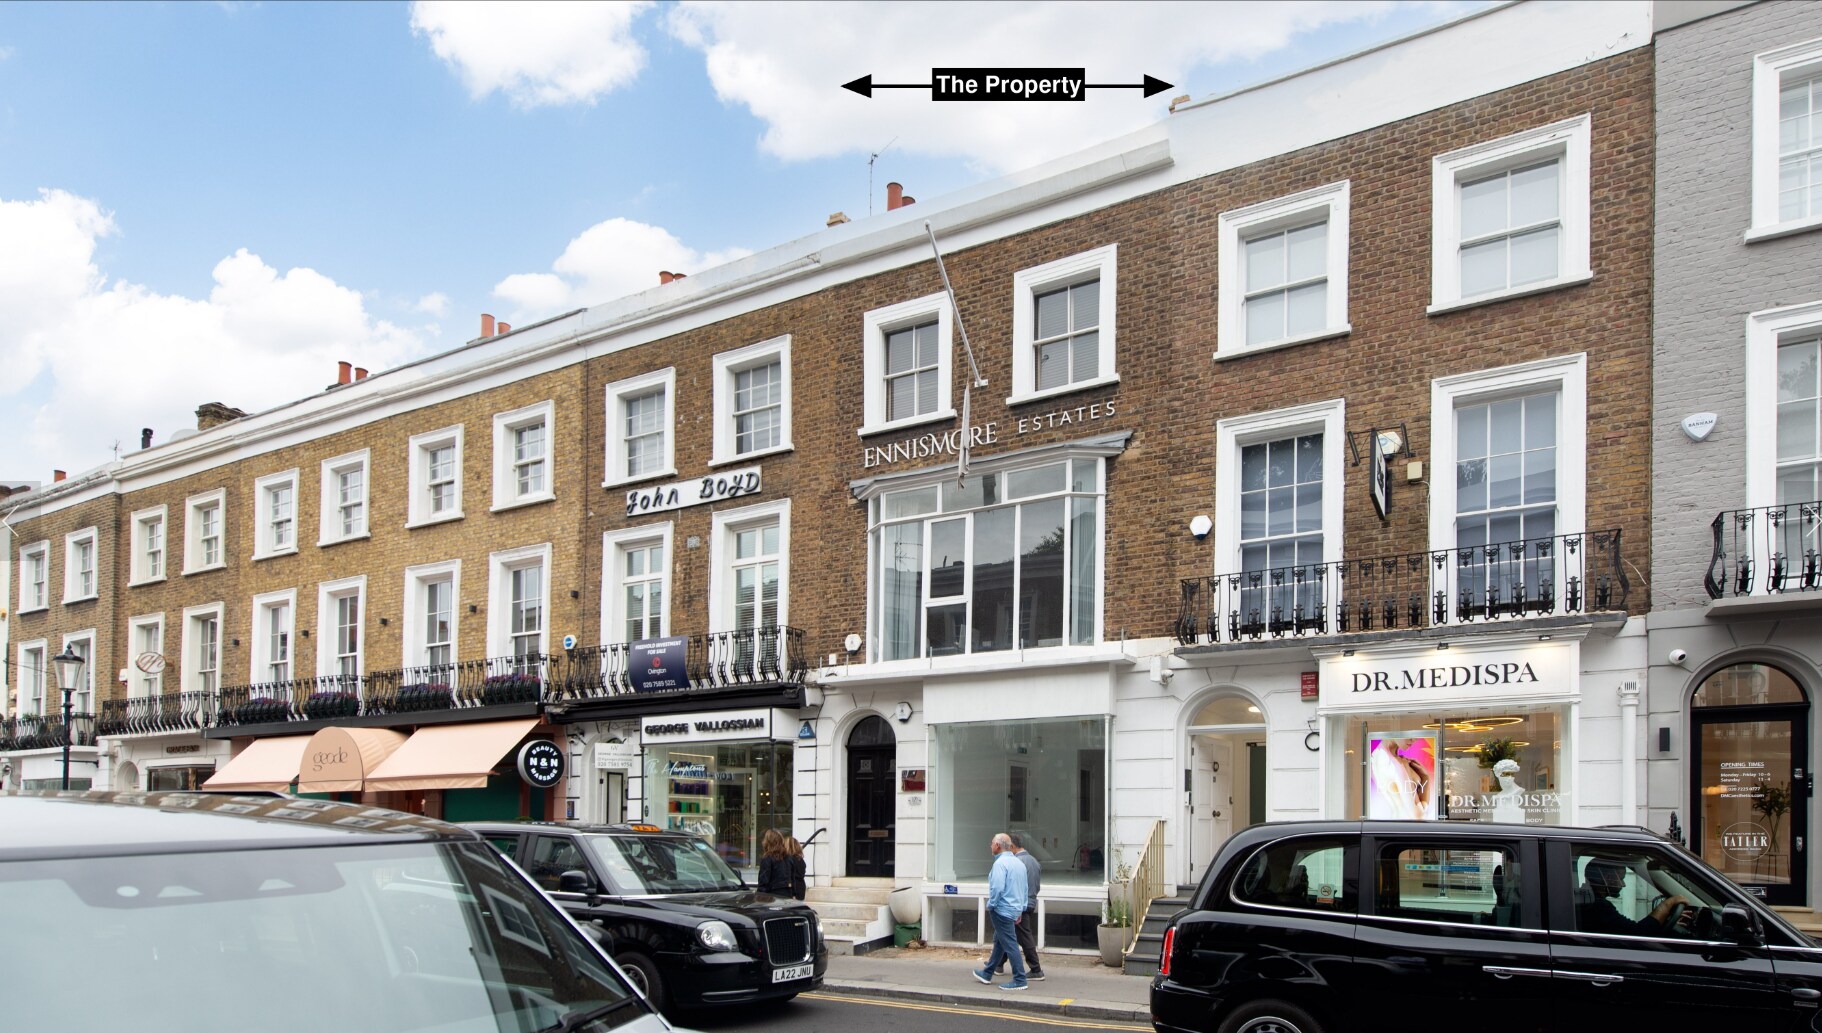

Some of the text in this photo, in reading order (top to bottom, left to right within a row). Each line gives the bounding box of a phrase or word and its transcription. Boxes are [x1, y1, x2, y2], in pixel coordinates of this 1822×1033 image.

[864, 401, 1116, 469] ENNISMORE ESTATES
[626, 471, 760, 514] John BOYD
[635, 640, 682, 650] FREEHOLD INVESTMENT
[647, 668, 667, 676] Ovington
[1351, 661, 1539, 693] DR.MEDISPA
[644, 718, 764, 735] GEORGE VALLOSSIAN
[312, 746, 348, 771] geode
[531, 745, 558, 757] BEAUTY
[529, 757, 559, 767] N & N
[661, 760, 706, 778] Hamptons
[530, 767, 558, 781] MASSAGE
[1376, 779, 1428, 794] ODY
[1724, 835, 1768, 847] TATLER
[775, 966, 811, 981] LA22 JNU
